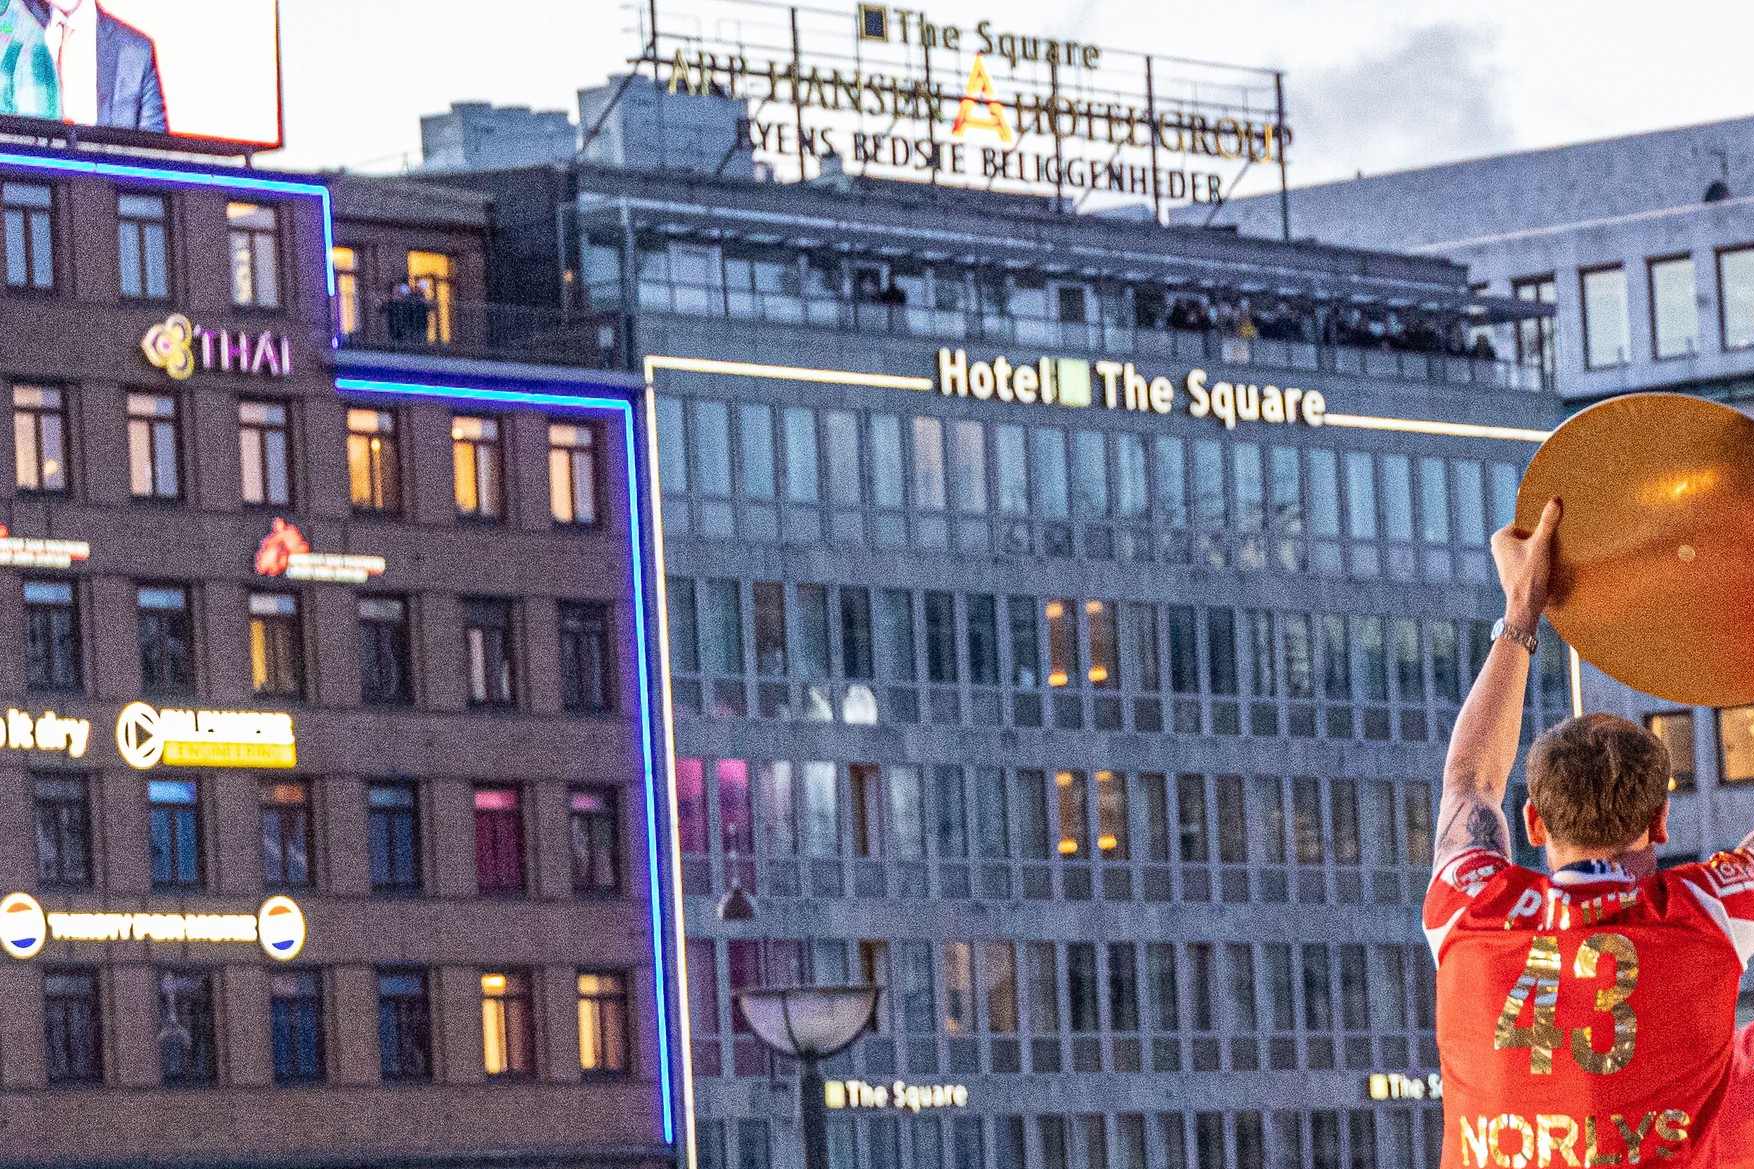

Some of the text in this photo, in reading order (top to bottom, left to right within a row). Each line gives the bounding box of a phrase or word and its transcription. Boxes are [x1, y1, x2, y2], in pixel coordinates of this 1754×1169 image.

[893, 9, 1101, 70] The Square
[1014, 92, 1150, 150] HOTEL
[854, 131, 966, 173] BEDSTE
[981, 148, 1224, 204] BELIGGENHEDER
[194, 325, 292, 376] THAI
[939, 346, 1327, 431] Hotel The Square
[1494, 933, 1639, 1076] 43
[845, 1079, 969, 1113] The Square
[1388, 1073, 1425, 1100] The
[1460, 1108, 1692, 1169] NORLYS
